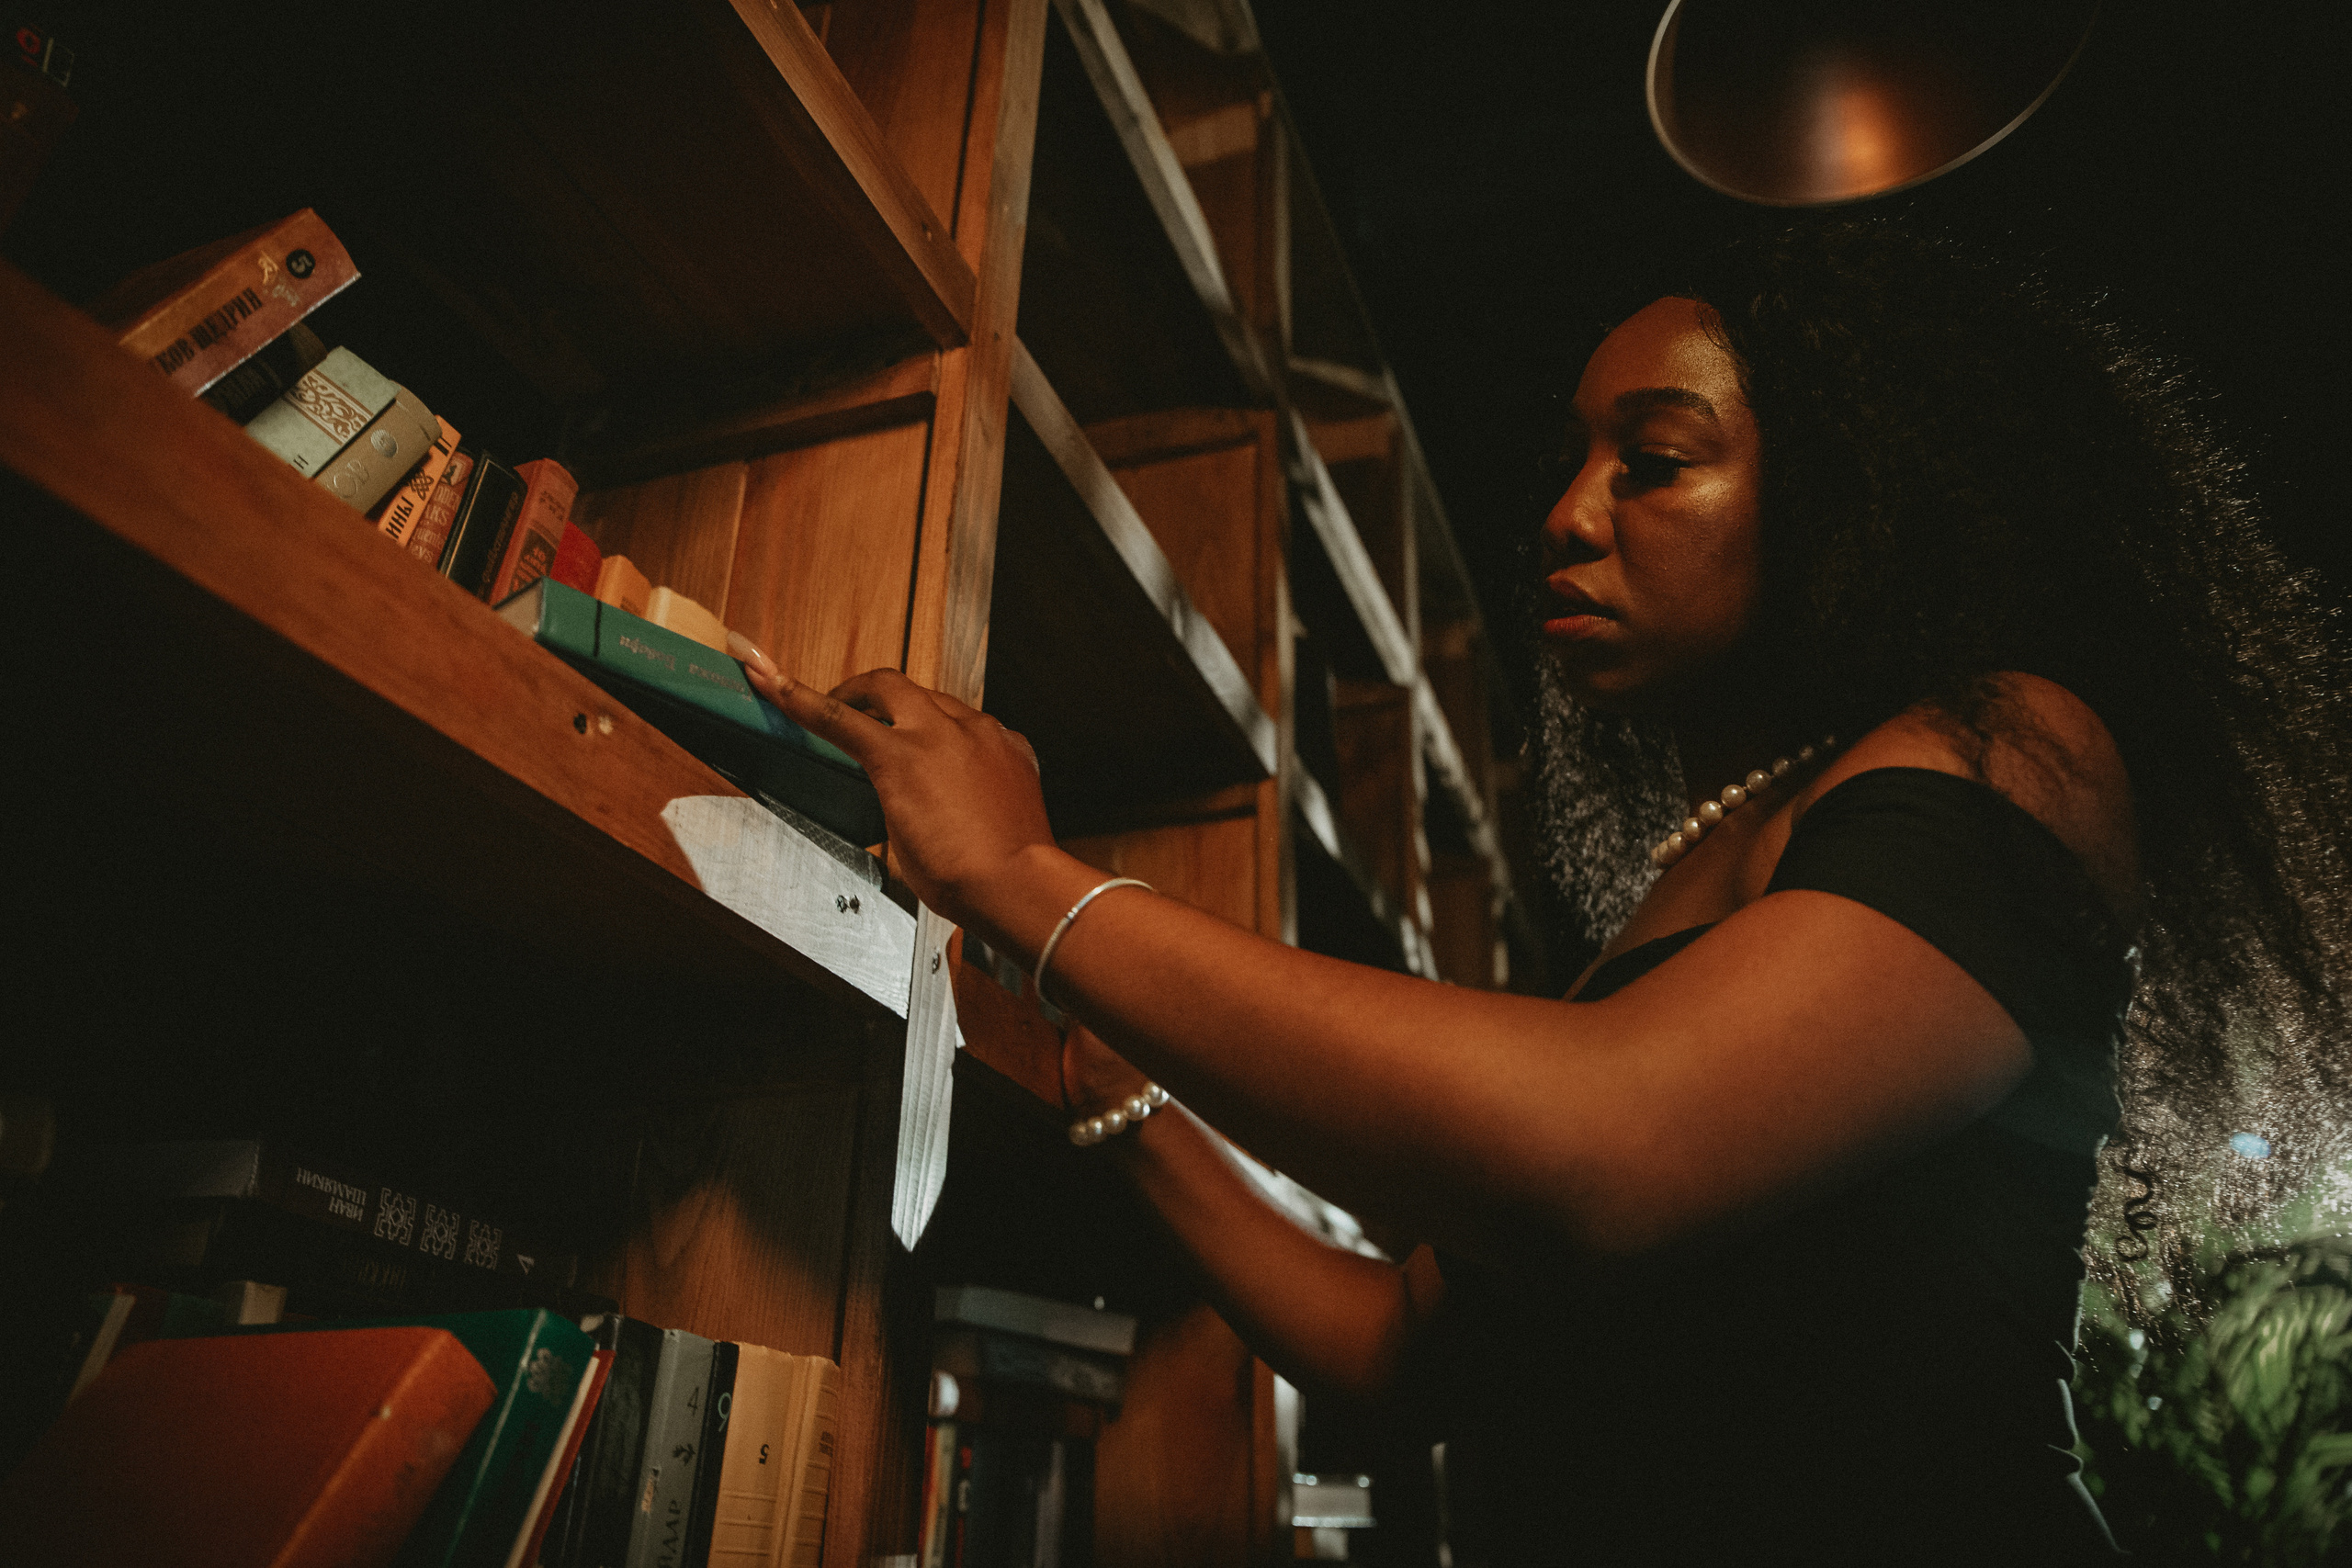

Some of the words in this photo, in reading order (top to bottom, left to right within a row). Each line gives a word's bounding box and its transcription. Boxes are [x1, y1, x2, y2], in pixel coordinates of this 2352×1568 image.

[290, 254, 313, 274] 5
[152, 337, 195, 377] КОВ
[187, 287, 263, 350] ЩЕДРИН
[327, 459, 369, 498] ОВ
[758, 1443, 770, 1465] 5
